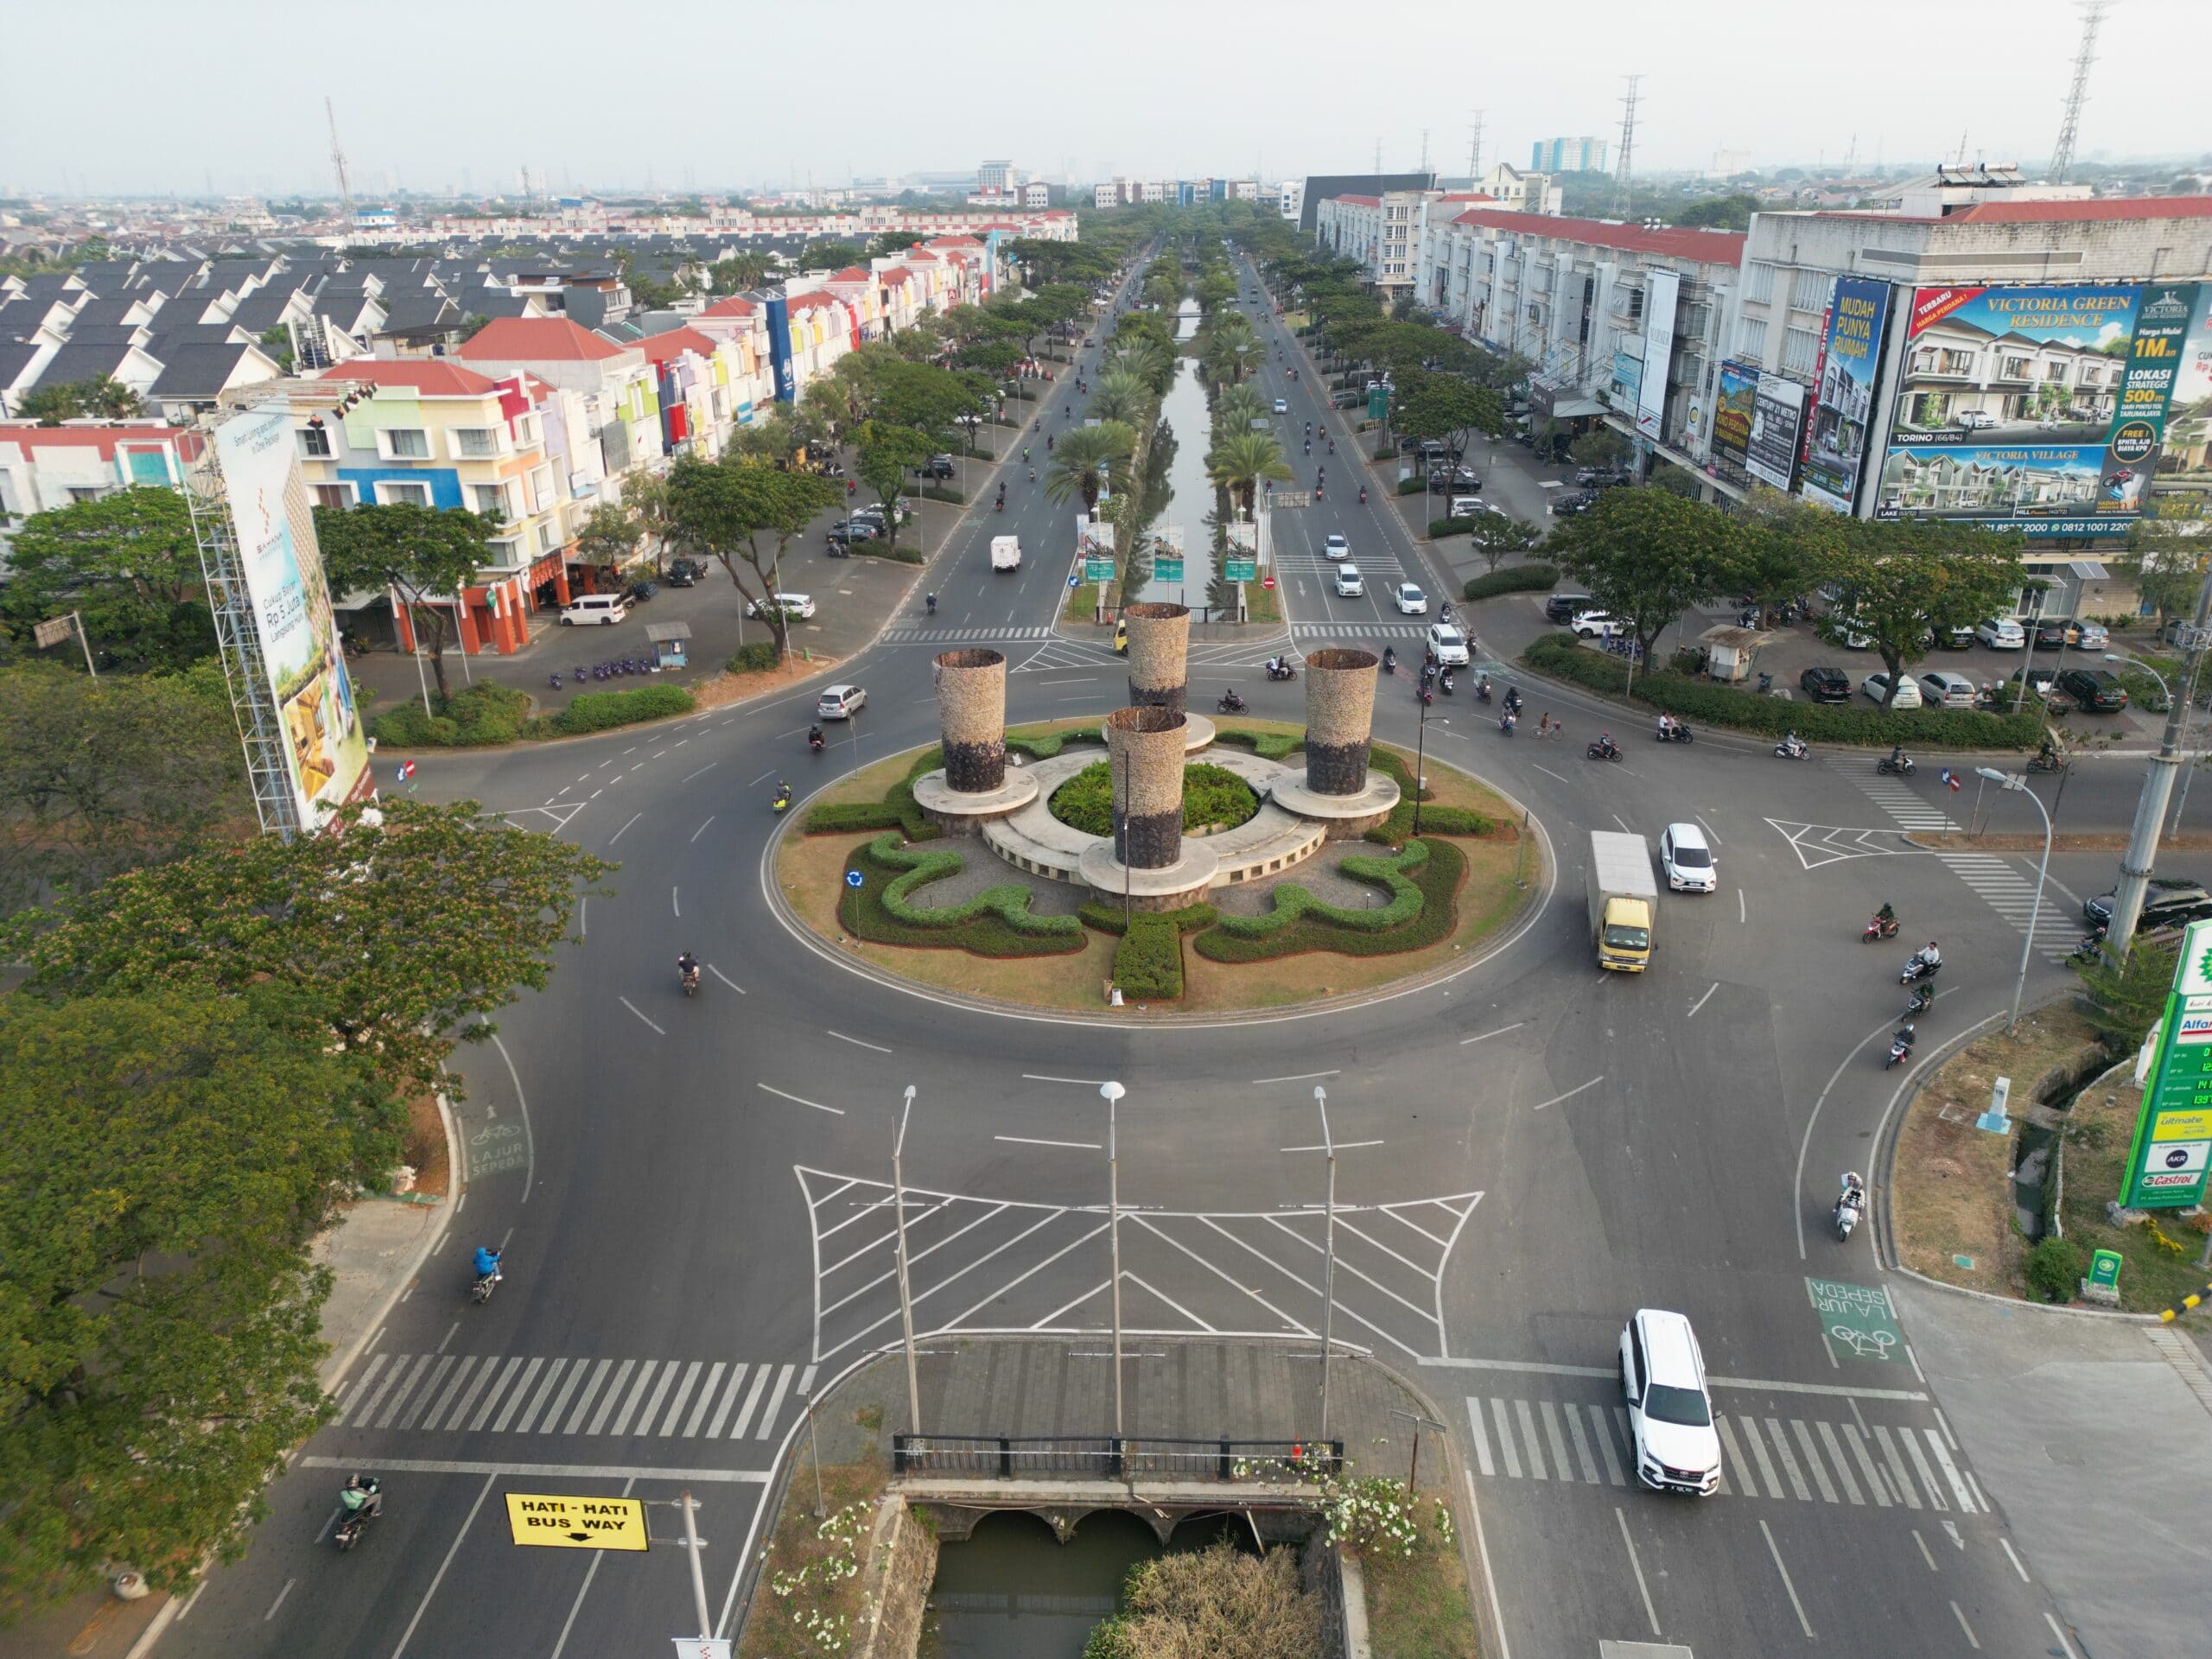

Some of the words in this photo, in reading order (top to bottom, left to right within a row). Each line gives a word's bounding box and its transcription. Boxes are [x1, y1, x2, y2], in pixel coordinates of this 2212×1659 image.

[1840, 296, 1877, 319] MUDAH
[1917, 289, 1952, 315] TERBARU
[1986, 296, 2069, 313] VICTORIA
[2072, 296, 2133, 311] GREEN
[1916, 313, 1937, 329] HARGA
[1936, 296, 1964, 316] PERDANA
[2143, 305, 2189, 315] VICTORIA
[1836, 315, 1872, 340] PUNYA
[2009, 313, 2103, 329] RESIDENCE
[2139, 327, 2160, 337] Harga
[1833, 335, 1869, 359] RUMAH
[1812, 315, 1832, 396] TERIMA
[2128, 369, 2172, 380] LOKASI
[2126, 380, 2169, 390] STRATEGIS
[1780, 406, 1797, 421] METRO
[234, 432, 247, 447] Smart
[1803, 406, 1816, 462] KOST
[1897, 433, 1934, 442] TORINO
[1935, 432, 1963, 442] (66/84)
[2122, 429, 2144, 438] FREE
[1975, 449, 2029, 461] VICTORIA
[2031, 449, 2079, 461] VILLAGE
[2024, 524, 2048, 532] 2000
[2062, 523, 2085, 531] 0812
[2086, 523, 2107, 531] 1001
[266, 613, 279, 628] Rp
[279, 604, 286, 620] 5
[287, 596, 301, 615] Juta
[2161, 1116, 2202, 1125] ultimate
[473, 1141, 523, 1164] LAJUR
[473, 1154, 526, 1176] SEPEDA
[2154, 1174, 2193, 1185] Castrol
[1811, 1281, 1886, 1306] SEPEDA
[1817, 1296, 1886, 1320] LAJUR
[522, 1501, 565, 1513] HATI
[583, 1503, 628, 1516] HATI
[527, 1516, 571, 1529] BUS
[582, 1519, 626, 1531] WAY
